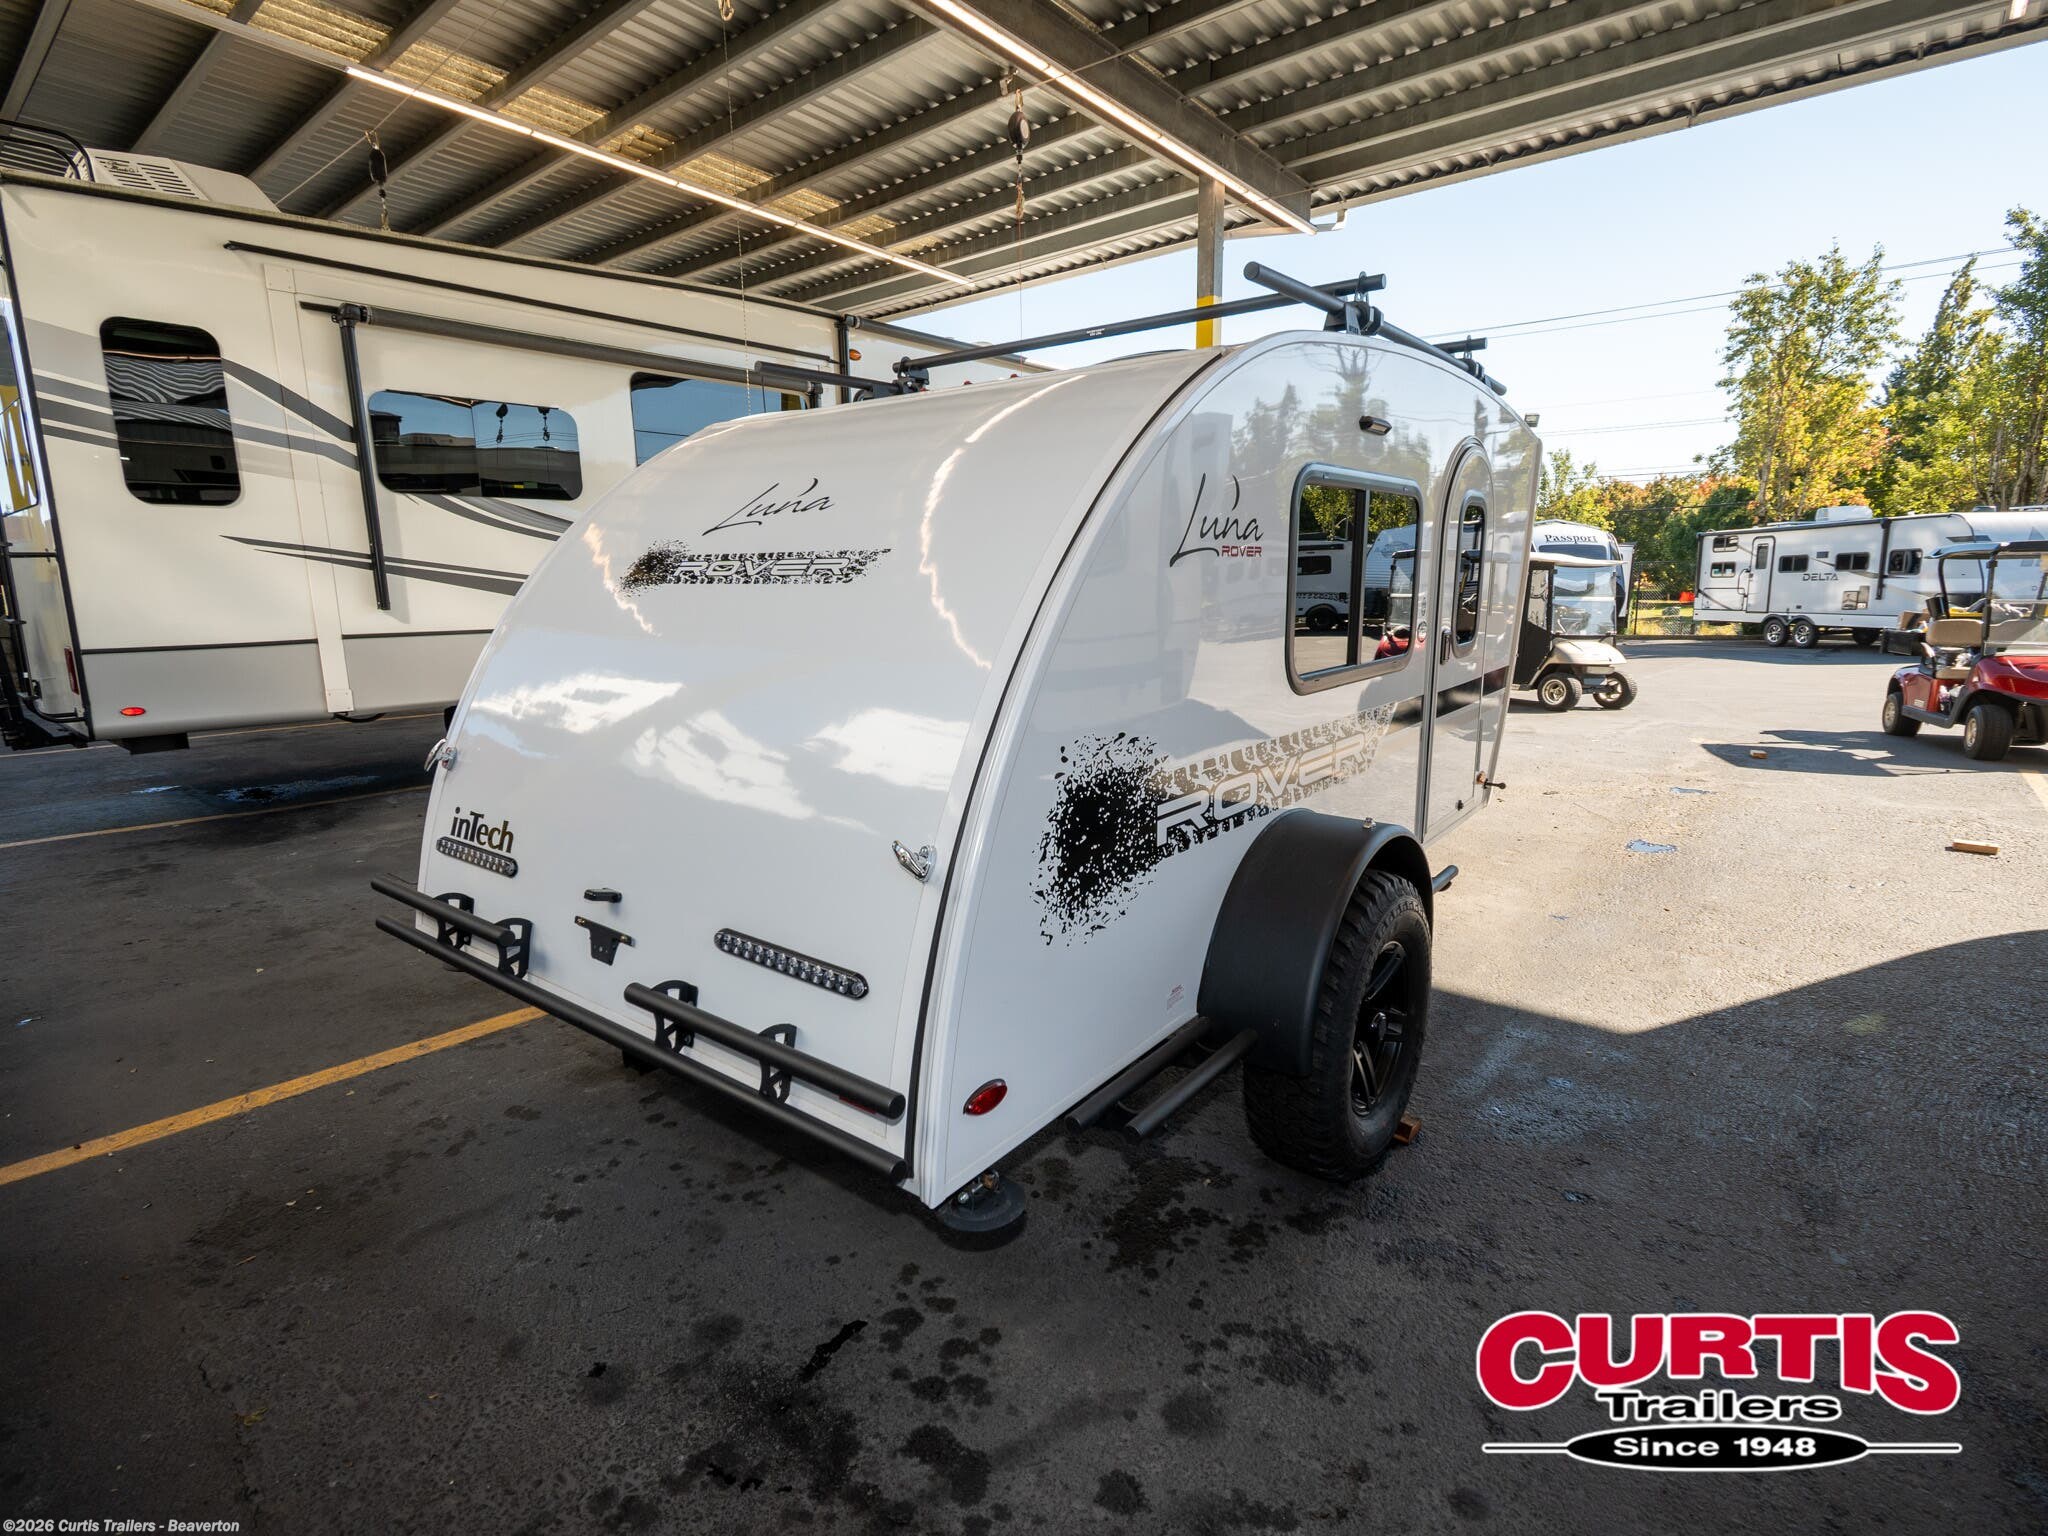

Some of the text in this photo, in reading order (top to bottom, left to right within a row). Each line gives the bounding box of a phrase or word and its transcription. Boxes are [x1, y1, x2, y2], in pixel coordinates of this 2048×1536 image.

[702, 477, 836, 536] Luna
[1169, 472, 1264, 567] Luna
[1221, 545, 1262, 557] ROVER
[1544, 534, 1599, 544] Passport
[673, 557, 851, 577] ROVER
[1802, 572, 1840, 582] DELTA
[1156, 732, 1367, 848] ROVER
[450, 806, 514, 854] inTech
